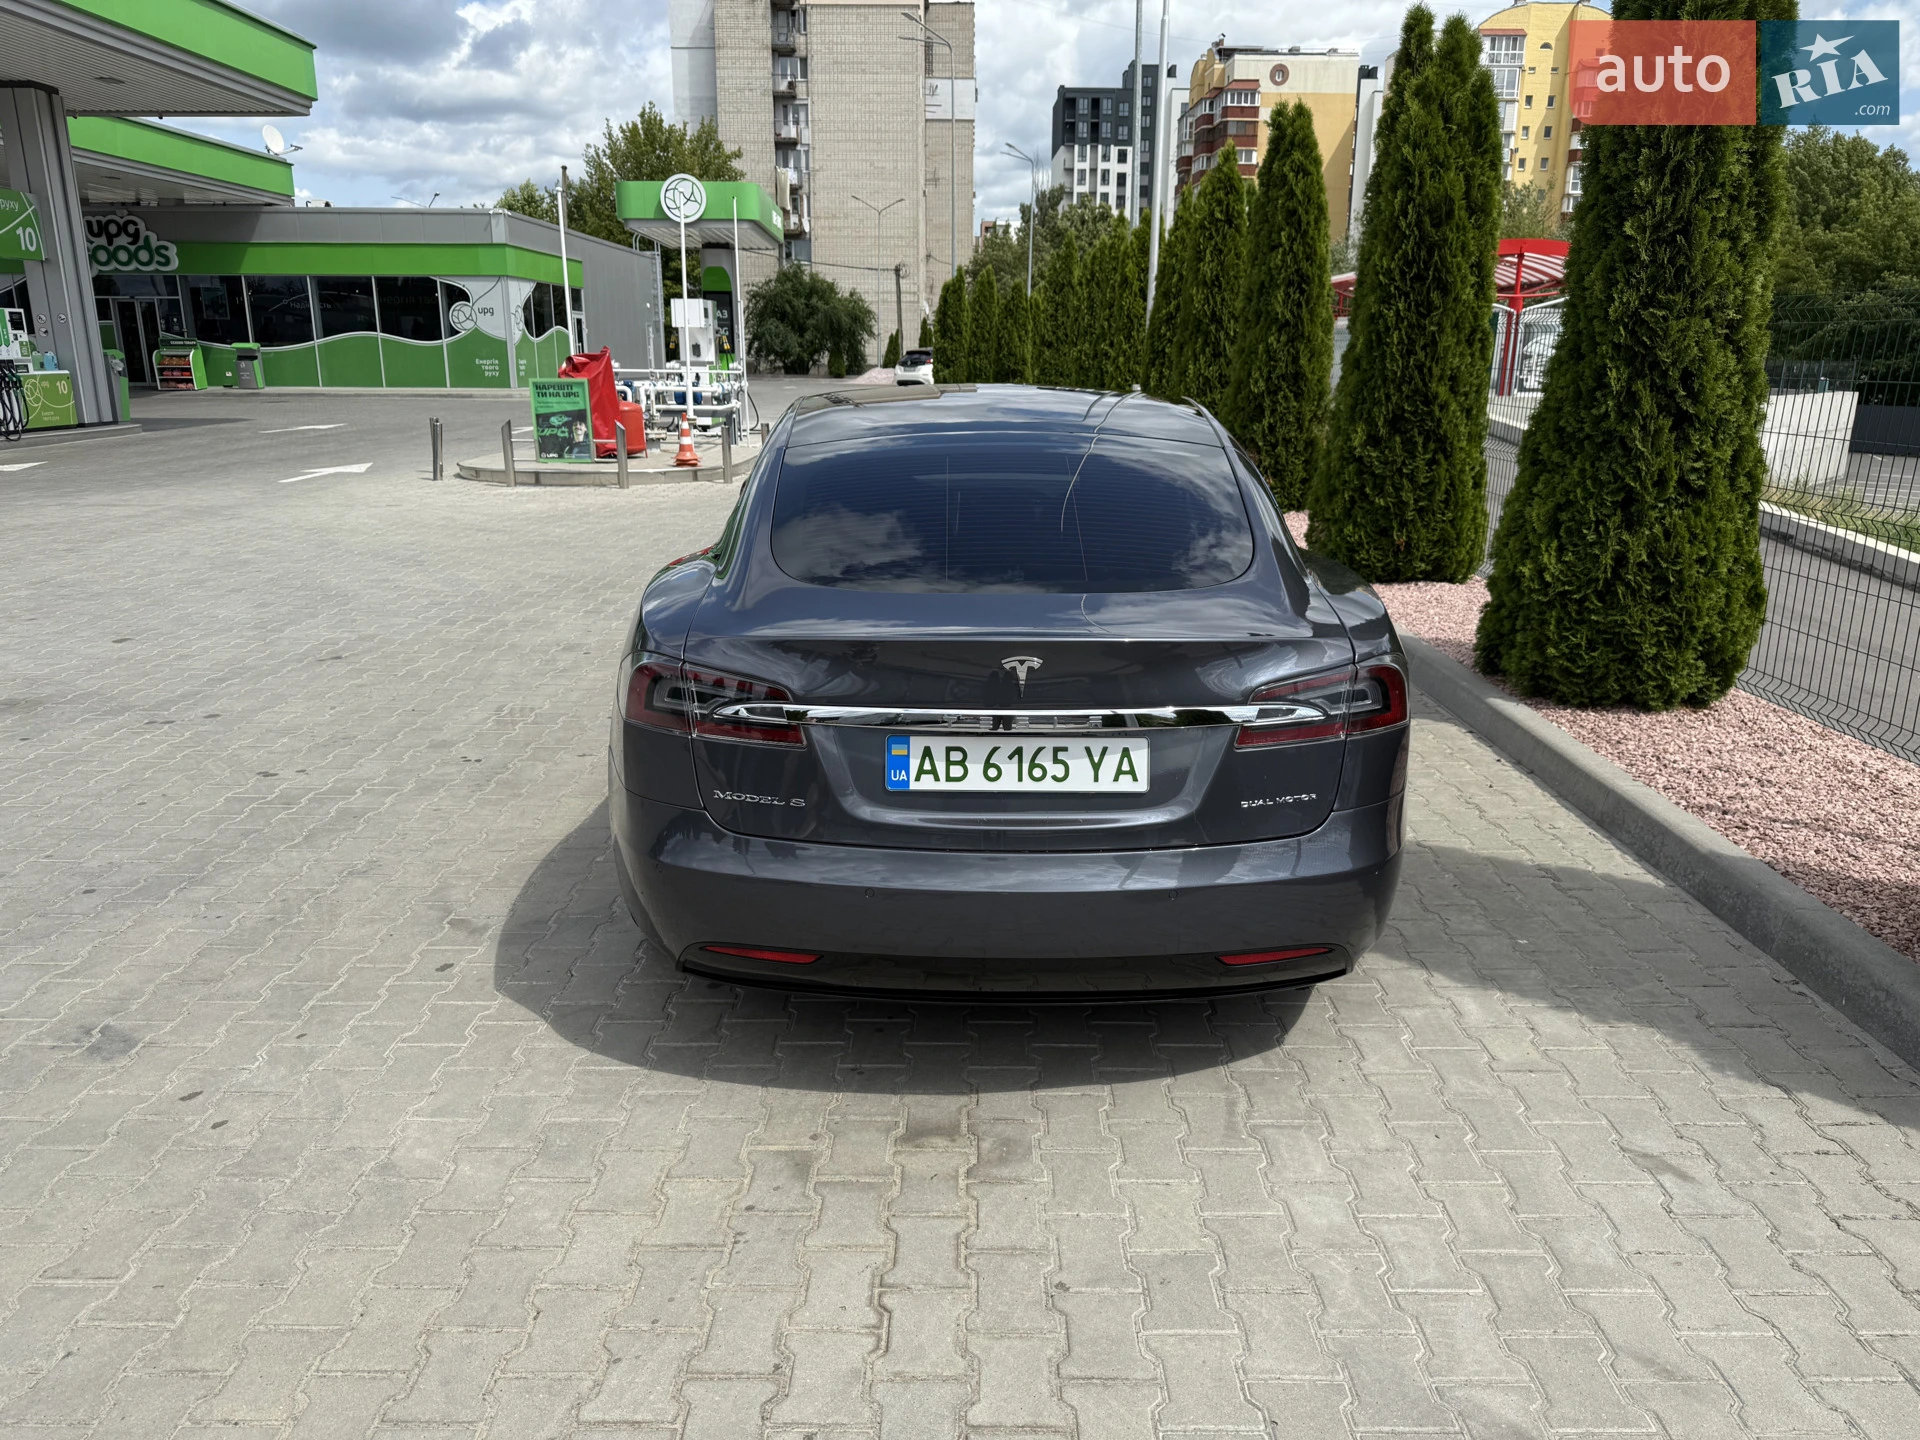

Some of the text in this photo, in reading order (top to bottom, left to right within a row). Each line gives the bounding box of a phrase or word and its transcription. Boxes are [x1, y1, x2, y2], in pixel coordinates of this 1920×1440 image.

[16, 226, 37, 252] 10
[85, 219, 140, 247] upg
[89, 234, 171, 267] oods
[477, 307, 495, 316] upg
[56, 380, 68, 394] 10
[914, 745, 1139, 783] AB 6165 YA
[891, 769, 908, 781] UA
[713, 789, 806, 807] MODEL S
[1240, 793, 1317, 808] DUAL MOTOR
